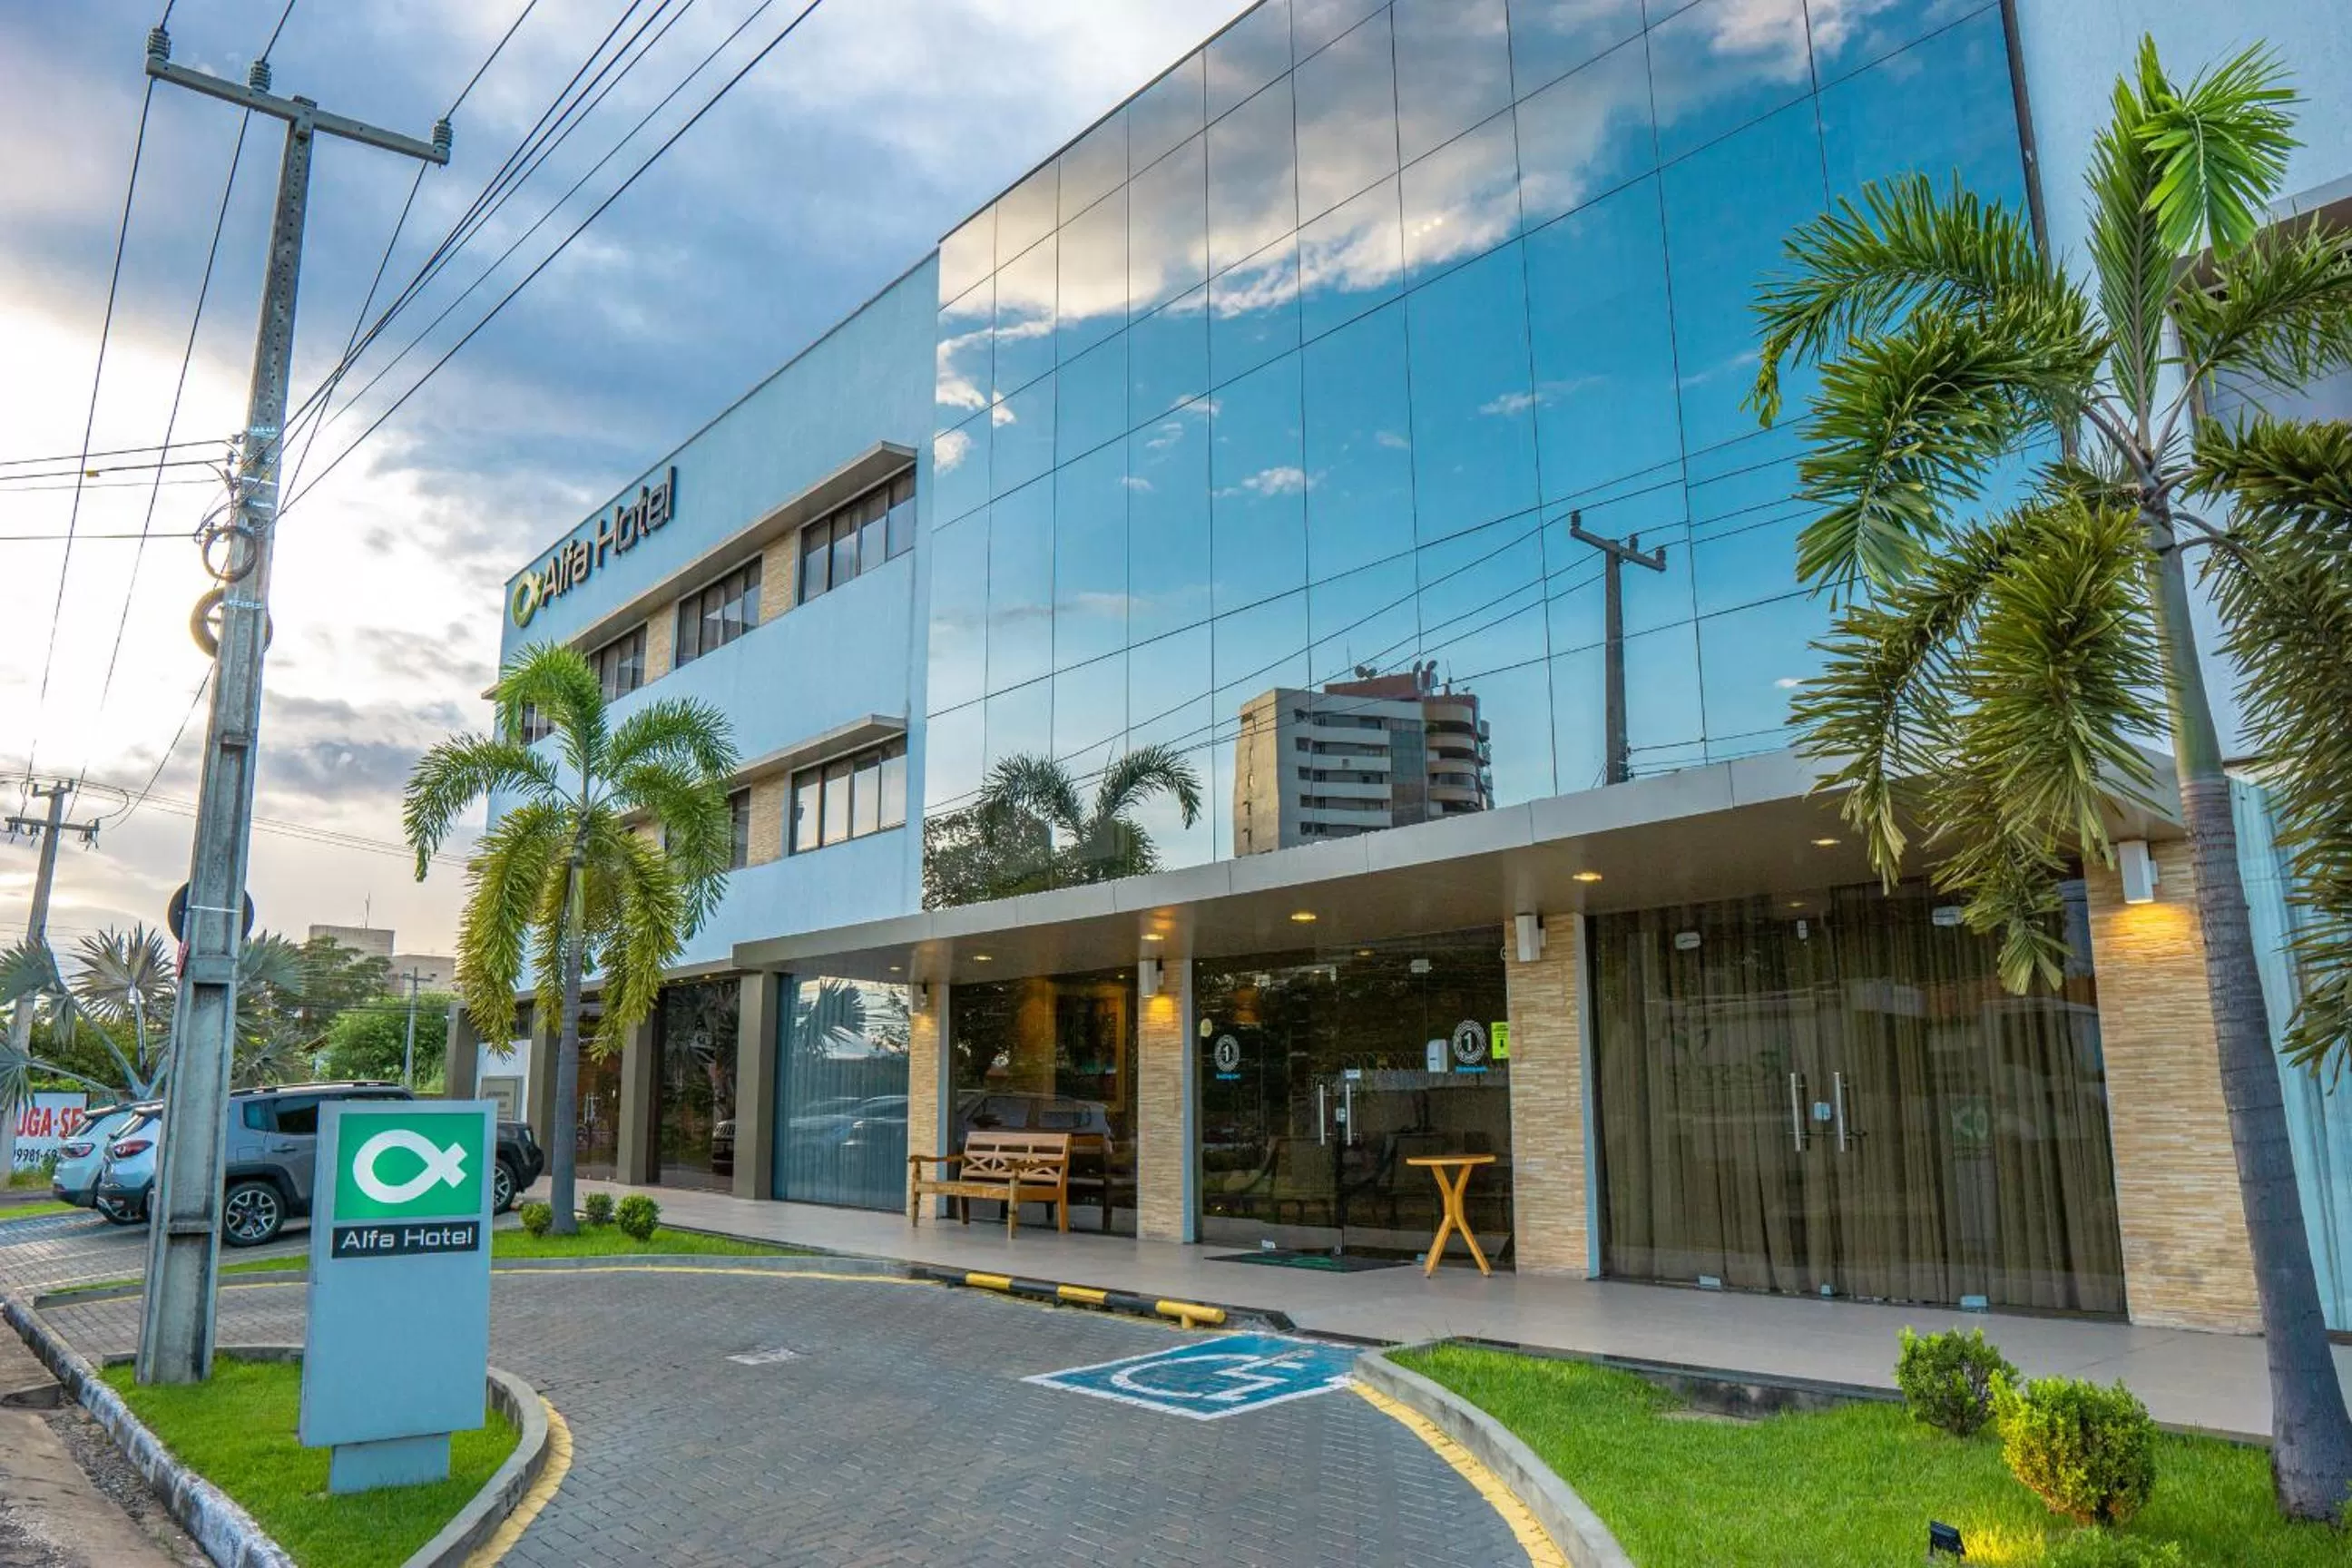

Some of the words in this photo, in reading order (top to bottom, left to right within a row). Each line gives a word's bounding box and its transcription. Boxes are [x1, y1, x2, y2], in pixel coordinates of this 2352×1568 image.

[541, 539, 592, 608] Alfa
[595, 466, 676, 568] Hotel
[341, 1230, 395, 1249] Alfa
[404, 1227, 473, 1248] Hotel
